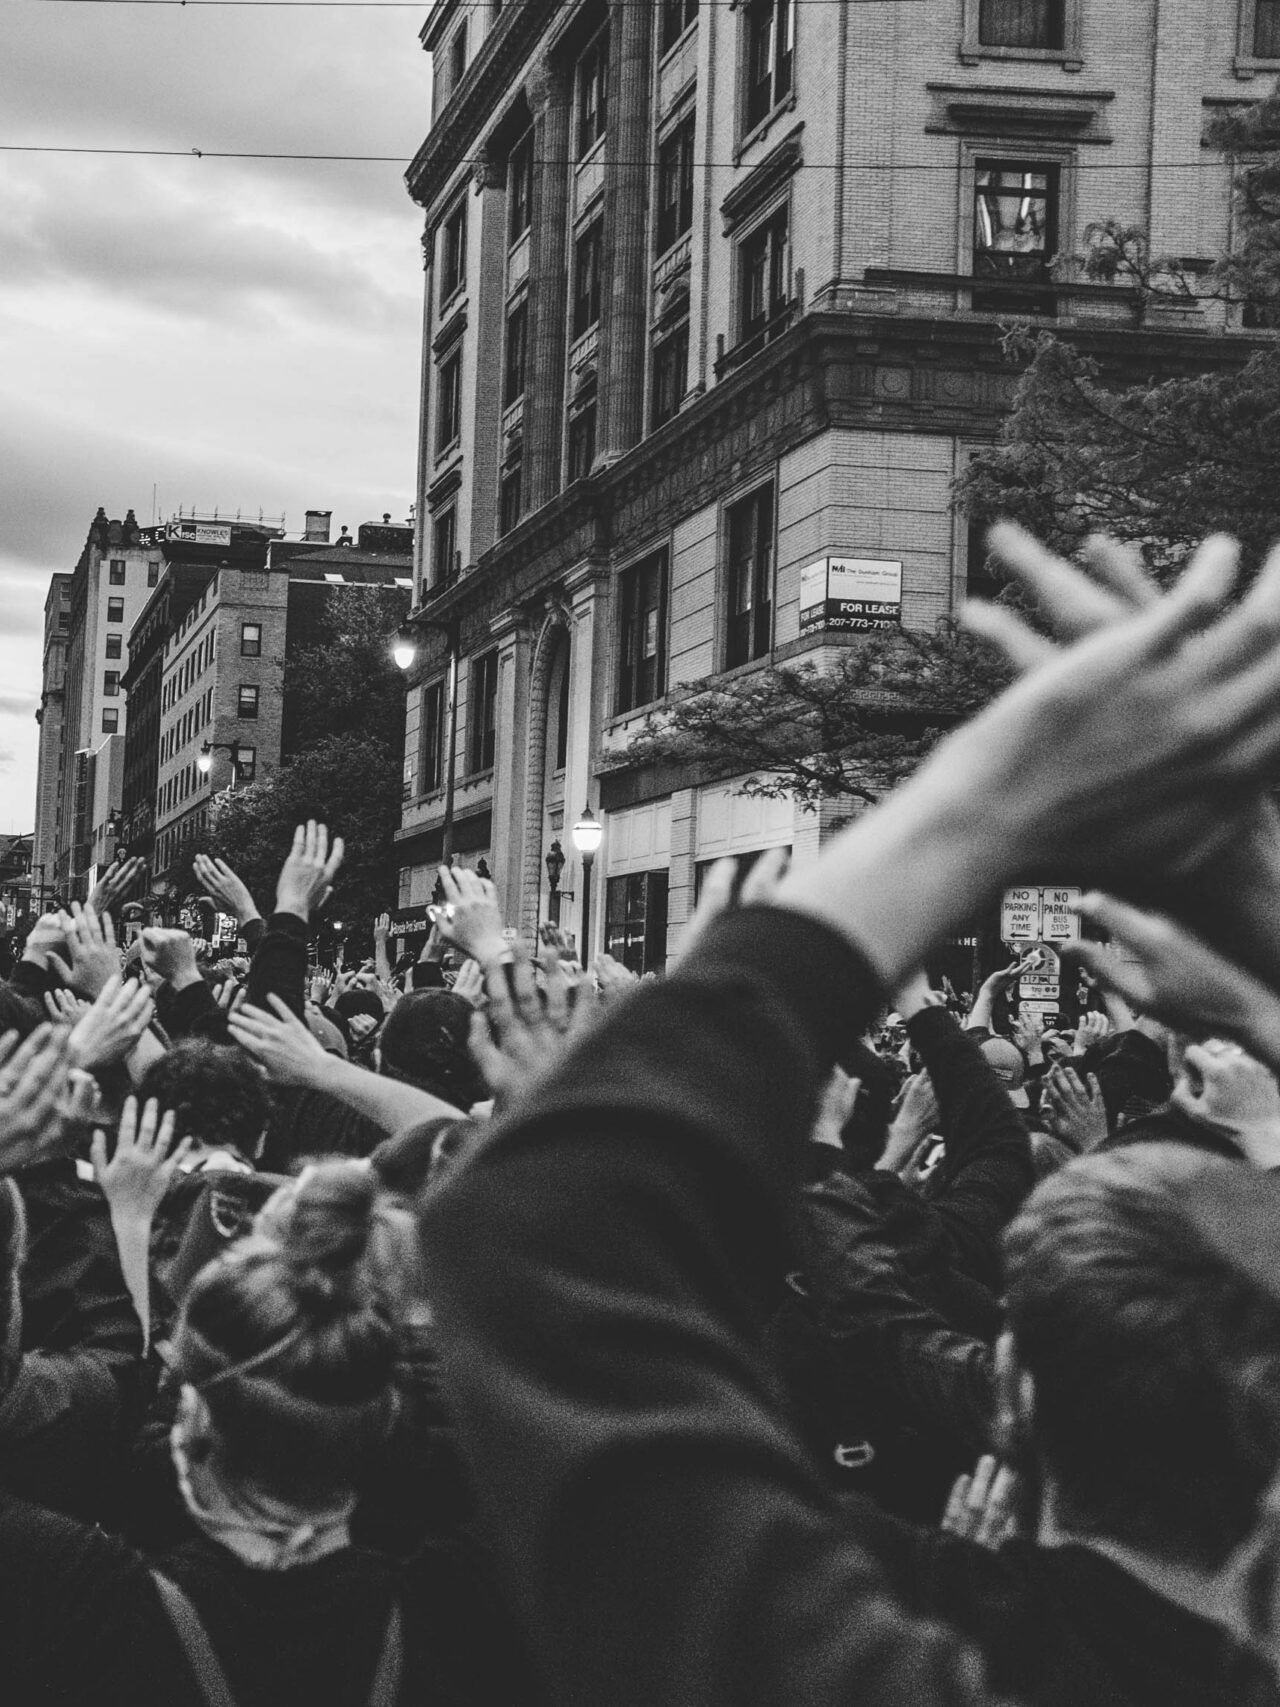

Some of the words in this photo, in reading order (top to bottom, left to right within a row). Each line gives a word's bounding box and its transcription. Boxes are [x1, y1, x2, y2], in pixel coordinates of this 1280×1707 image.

[168, 525, 180, 538] K
[840, 602, 862, 613] FOR
[865, 605, 899, 615] LEASE
[1012, 891, 1030, 900] NO
[1053, 892, 1069, 903] NO
[1004, 903, 1037, 912] PARKING
[1012, 914, 1030, 922] ANY
[1010, 923, 1032, 931] TIME
[1051, 924, 1070, 932] STOP
